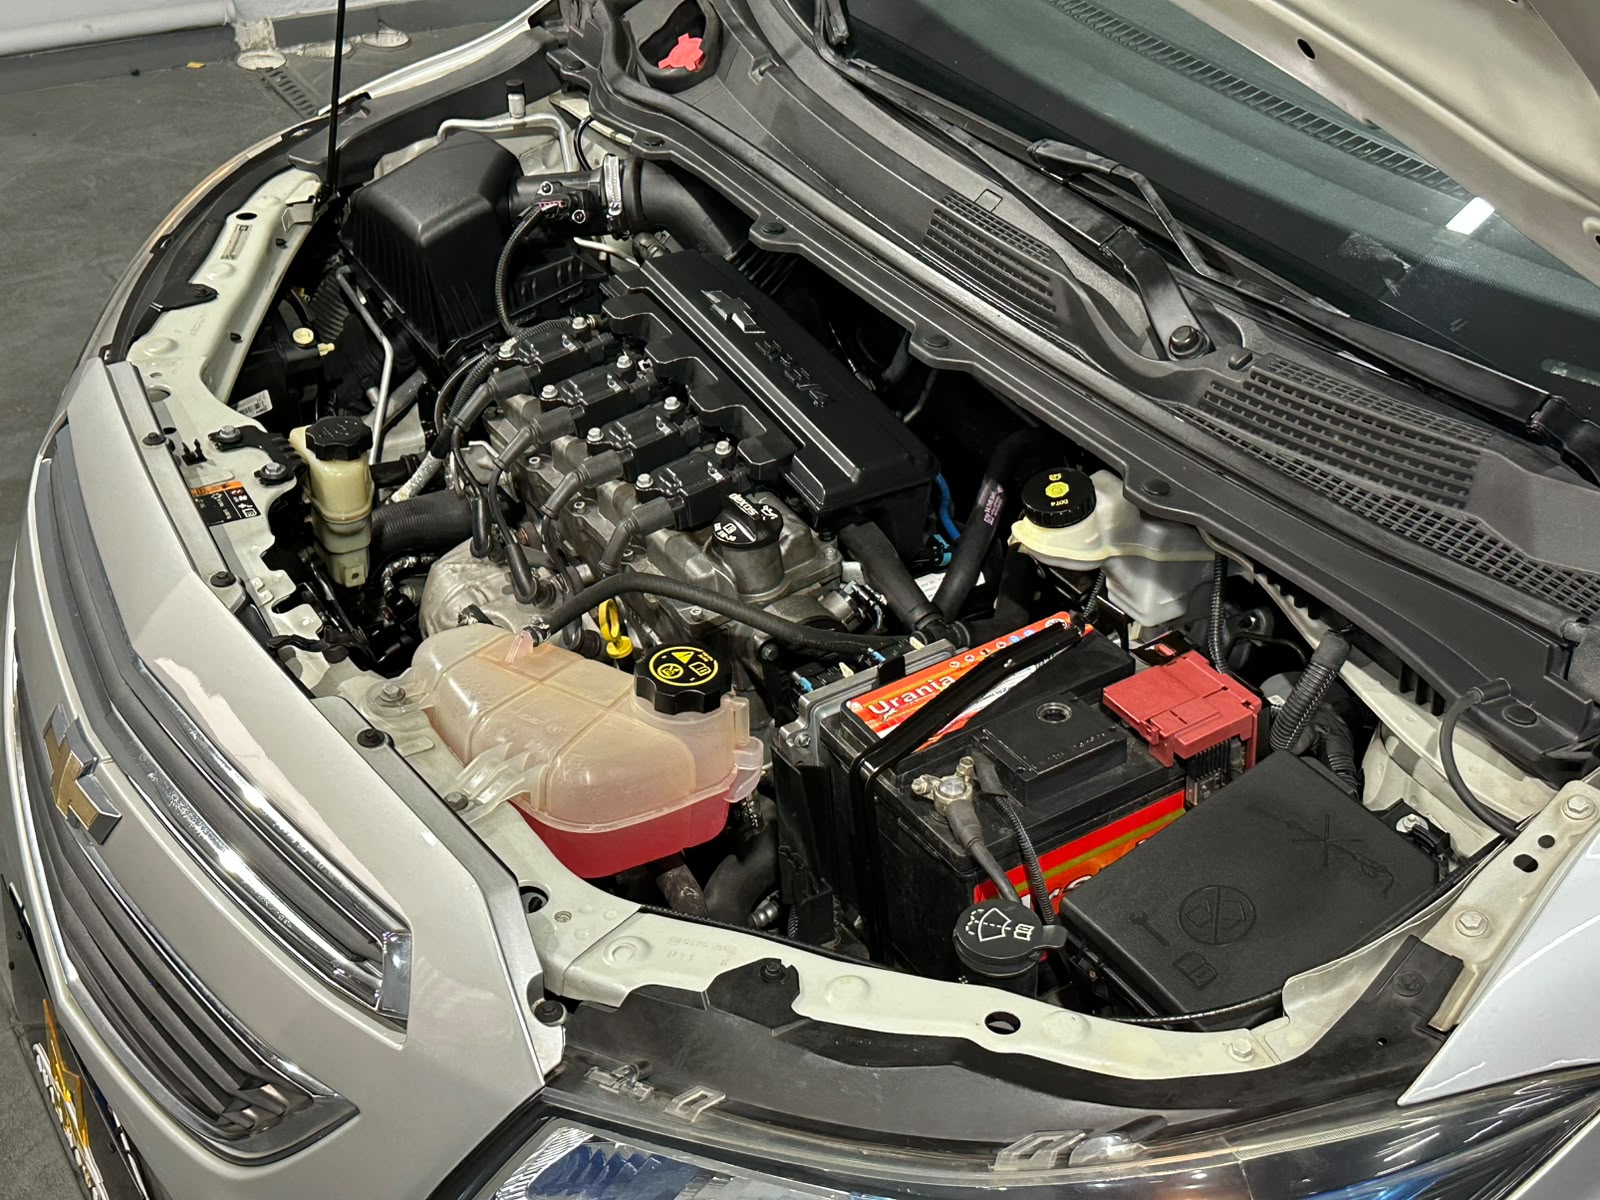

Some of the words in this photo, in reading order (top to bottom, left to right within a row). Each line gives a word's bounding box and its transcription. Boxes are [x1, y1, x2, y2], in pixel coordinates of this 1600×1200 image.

[728, 493, 760, 516] dexos
[1055, 498, 1069, 506] DOT
[868, 675, 956, 714] Urania
